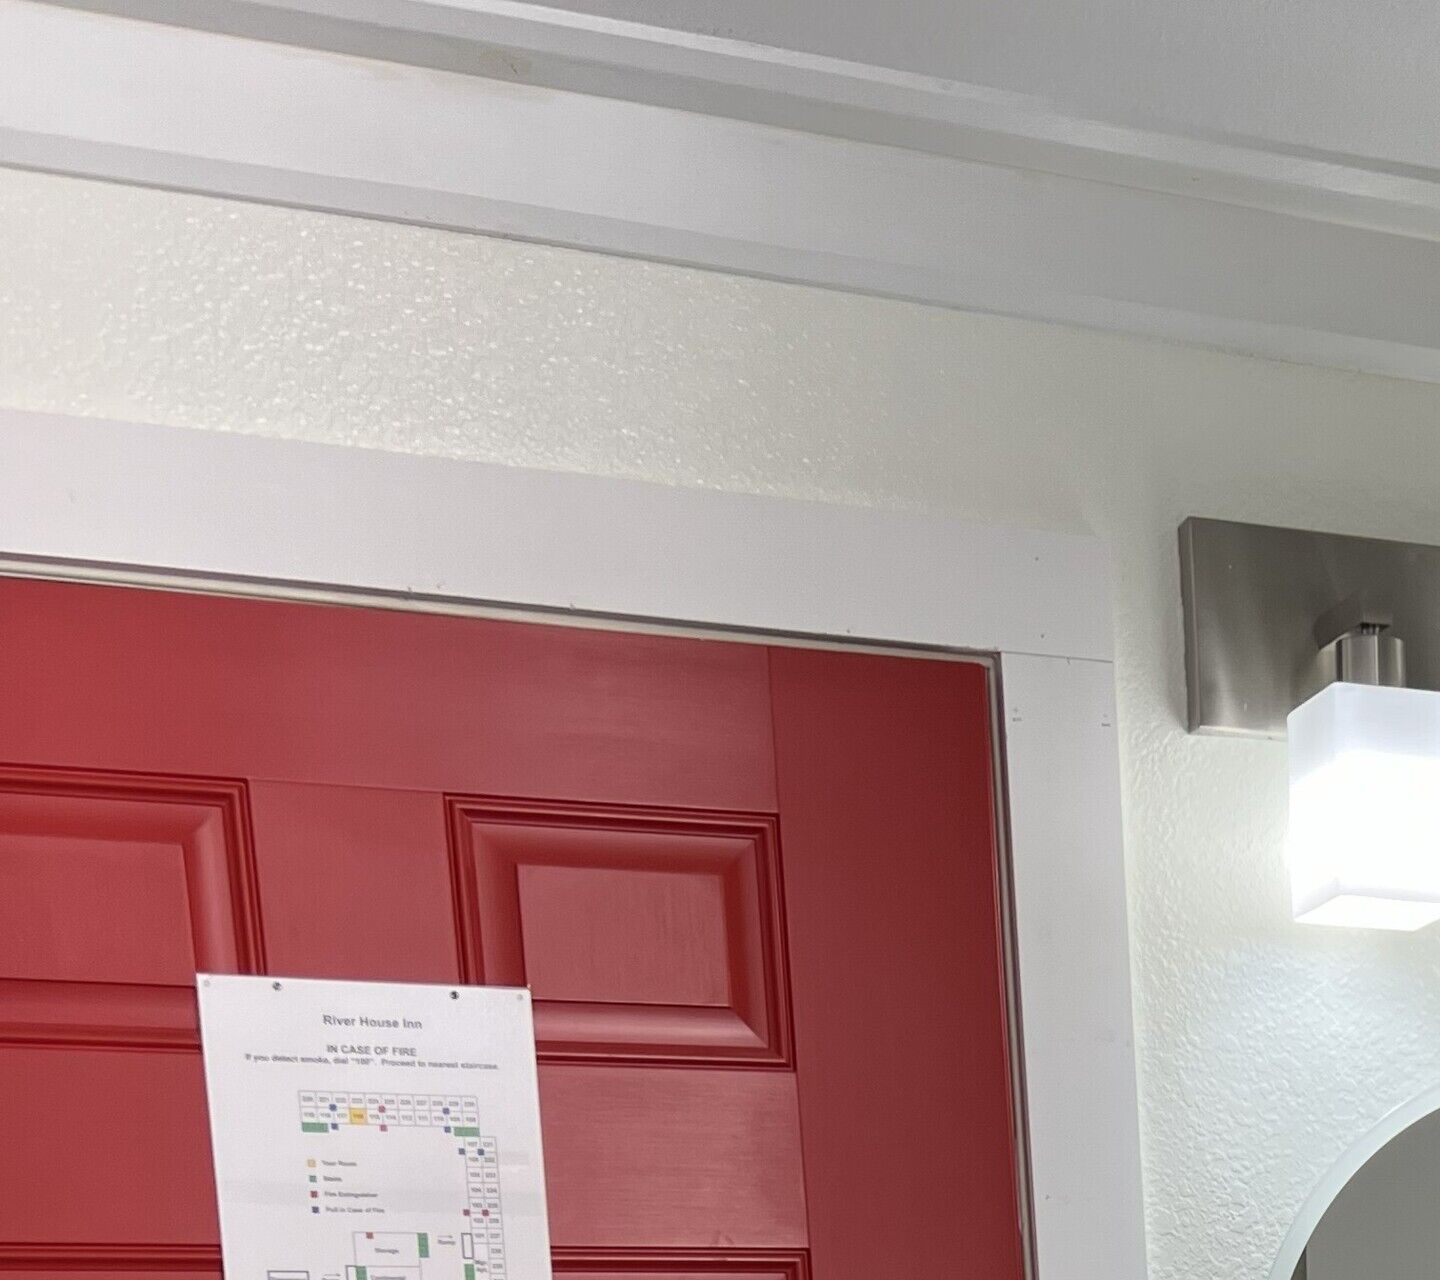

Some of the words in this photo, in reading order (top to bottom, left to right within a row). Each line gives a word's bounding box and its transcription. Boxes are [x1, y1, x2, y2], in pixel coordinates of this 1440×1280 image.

[322, 1014, 355, 1027] River
[359, 1016, 399, 1028] House
[402, 1017, 423, 1029] Inn
[326, 1044, 338, 1053] IN
[340, 1044, 371, 1055] CASE
[374, 1046, 389, 1056] OF
[392, 1046, 417, 1056] FIRE
